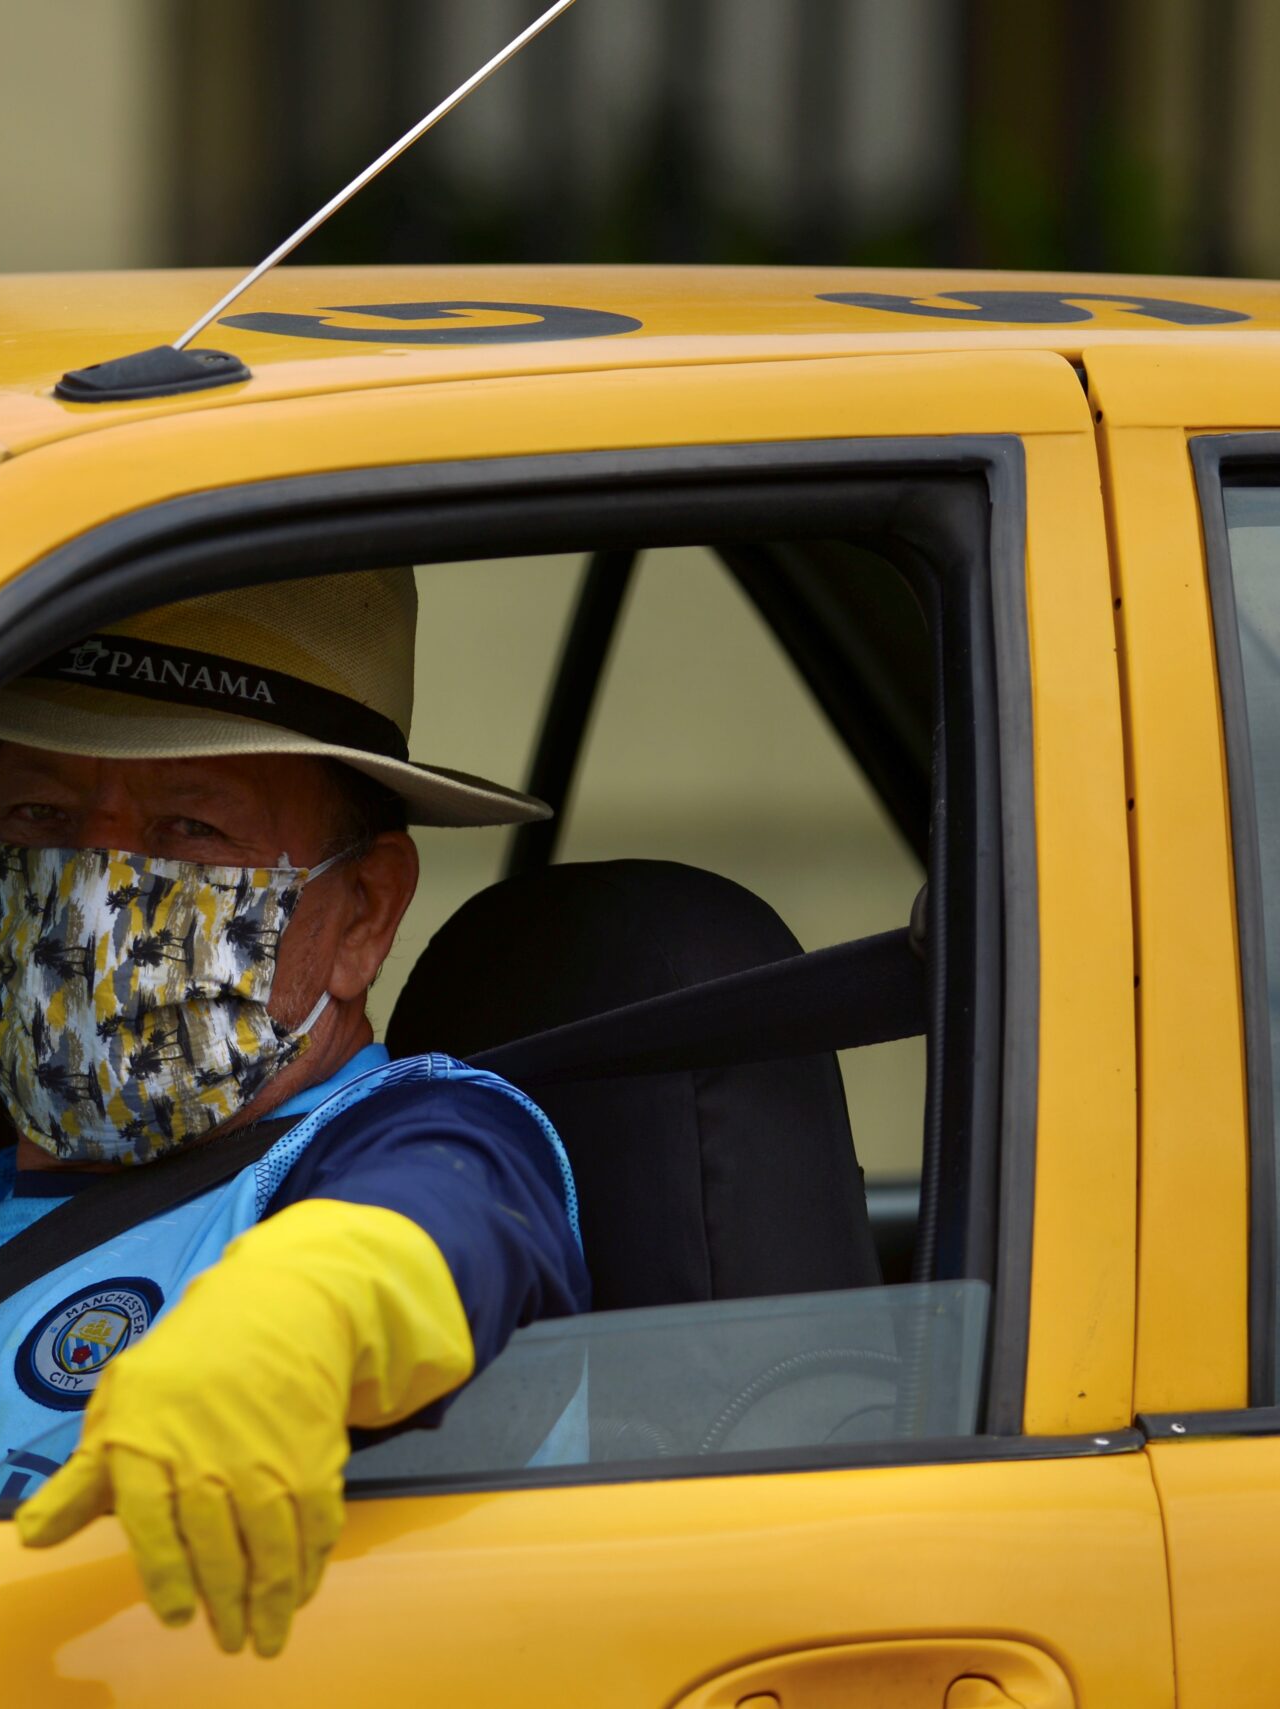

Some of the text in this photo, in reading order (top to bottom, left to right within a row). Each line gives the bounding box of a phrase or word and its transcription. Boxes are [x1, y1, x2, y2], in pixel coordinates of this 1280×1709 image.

[108, 651, 276, 704] PANAMA
[66, 1293, 145, 1334] MANCHESTER
[49, 1371, 83, 1390] CITY
